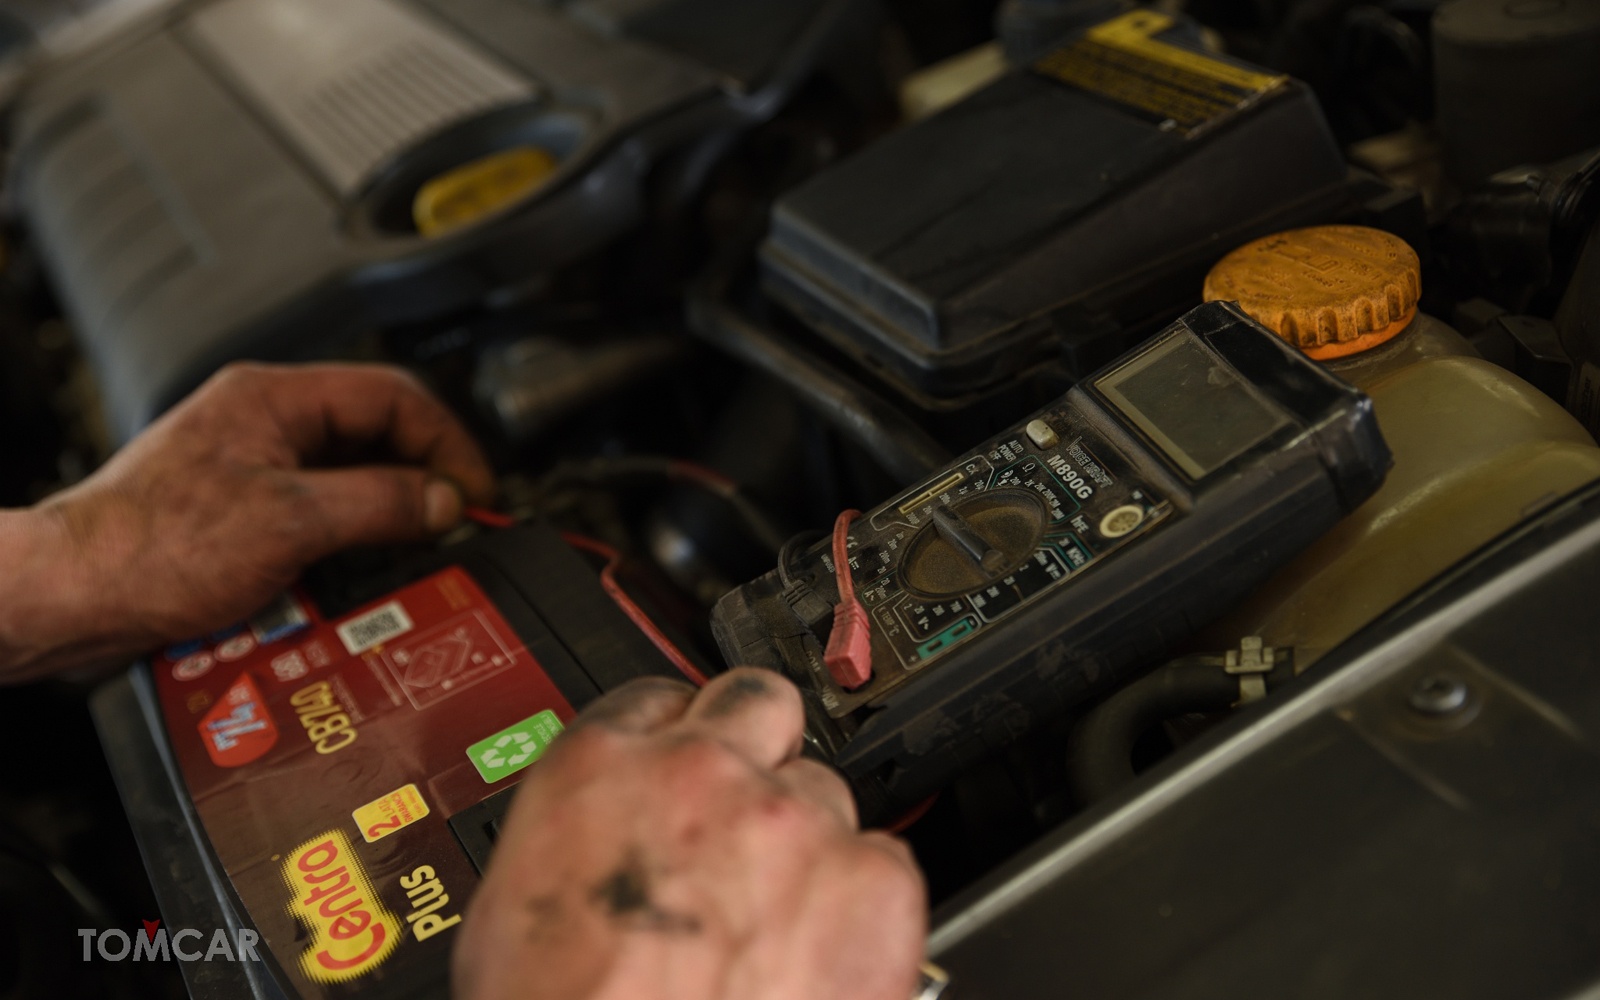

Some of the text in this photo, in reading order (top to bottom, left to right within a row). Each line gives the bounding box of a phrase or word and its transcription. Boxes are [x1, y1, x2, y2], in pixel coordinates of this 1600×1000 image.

[997, 444, 1016, 461] POWER
[1009, 440, 1023, 452] AUTO
[1046, 454, 1094, 500] M890G
[880, 612, 895, 626] TEMP
[366, 814, 401, 838] 2
[297, 840, 387, 971] Centra
[399, 863, 461, 942] Plus
